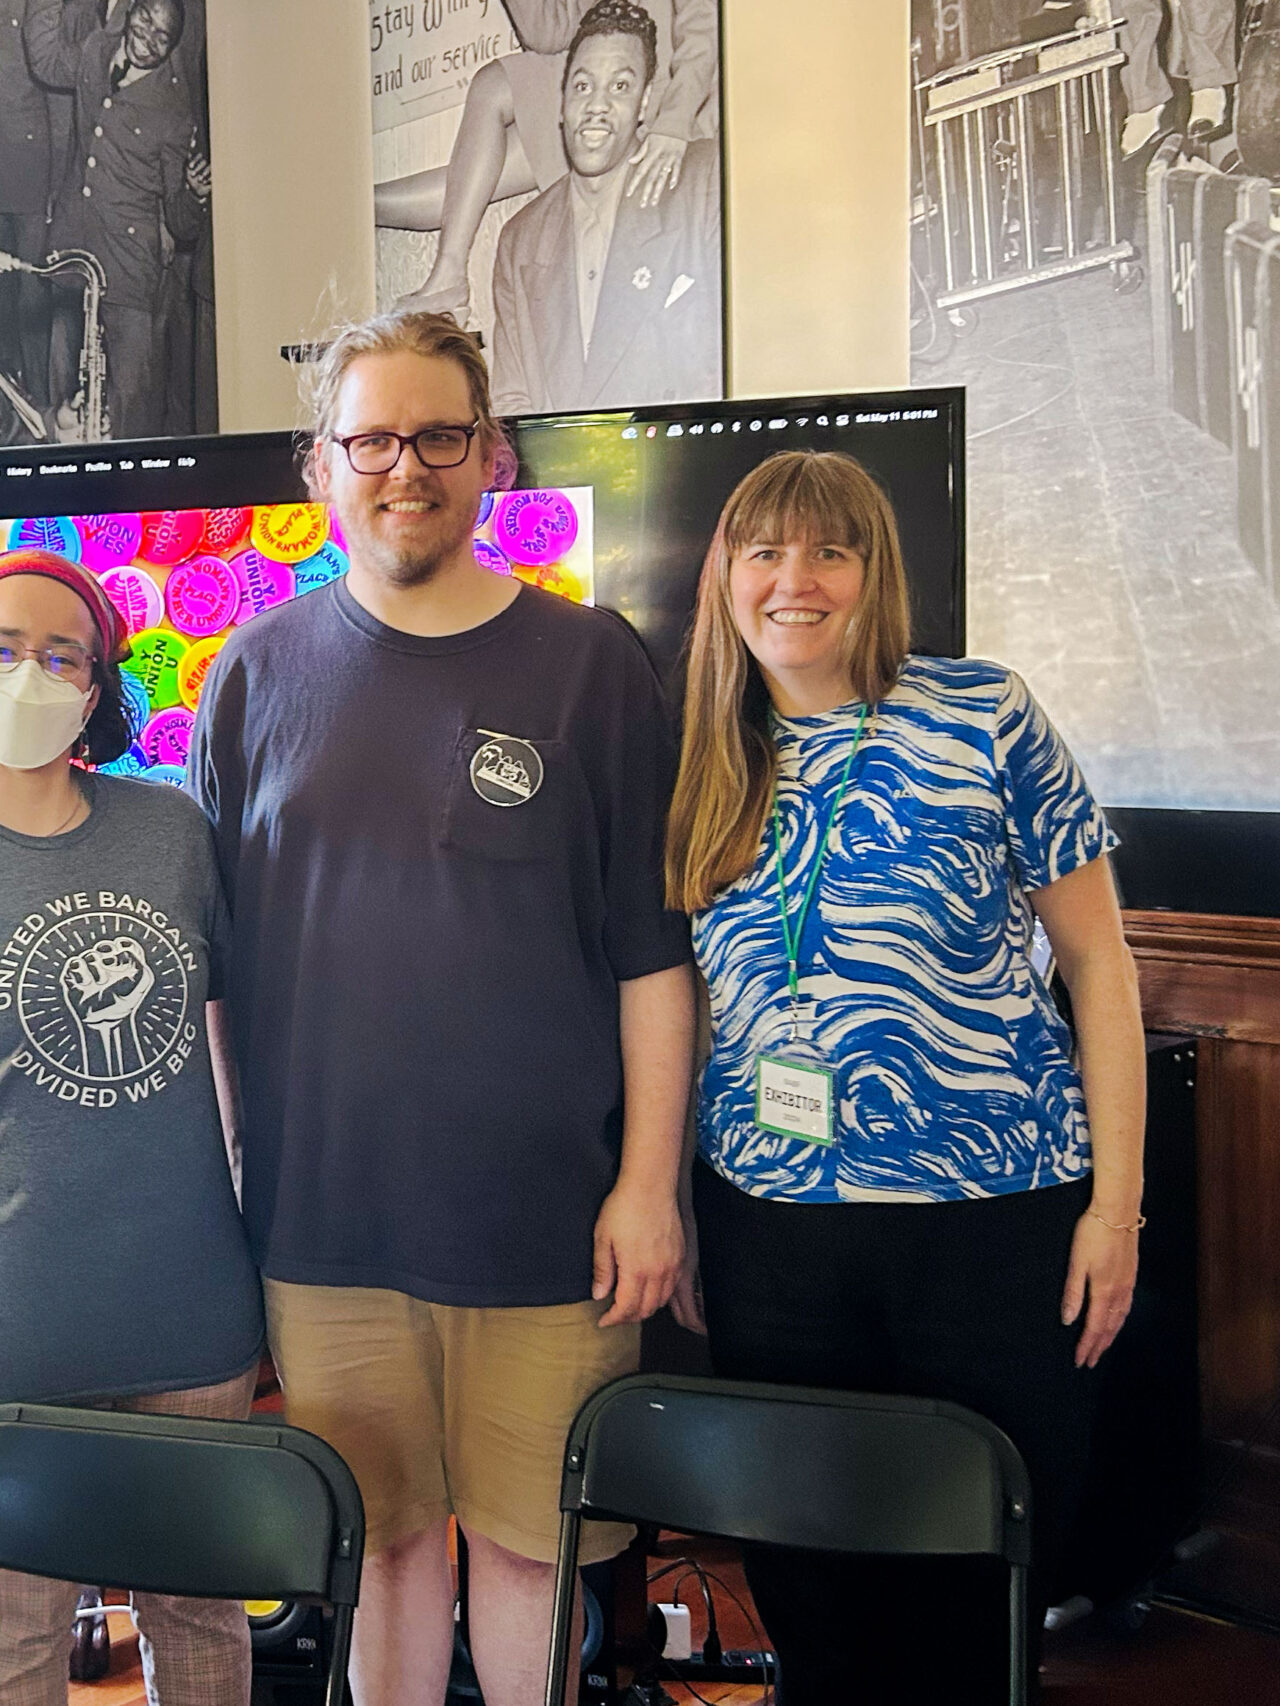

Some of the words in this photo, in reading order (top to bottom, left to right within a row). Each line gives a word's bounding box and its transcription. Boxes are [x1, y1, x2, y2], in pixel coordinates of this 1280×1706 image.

[371, 4, 414, 52] Stay
[373, 54, 403, 96] and
[411, 55, 437, 83] our
[6, 467, 33, 476] History
[94, 531, 125, 555] YES
[245, 553, 266, 614] UNION
[145, 639, 168, 698] UNION
[45, 891, 92, 917] WE
[98, 890, 198, 972] BARGAIN
[11, 1049, 118, 1109] DIVIDED
[123, 1073, 167, 1104] WE
[166, 1021, 198, 1075] BEG
[764, 1086, 823, 1113] EXHIBITOR
